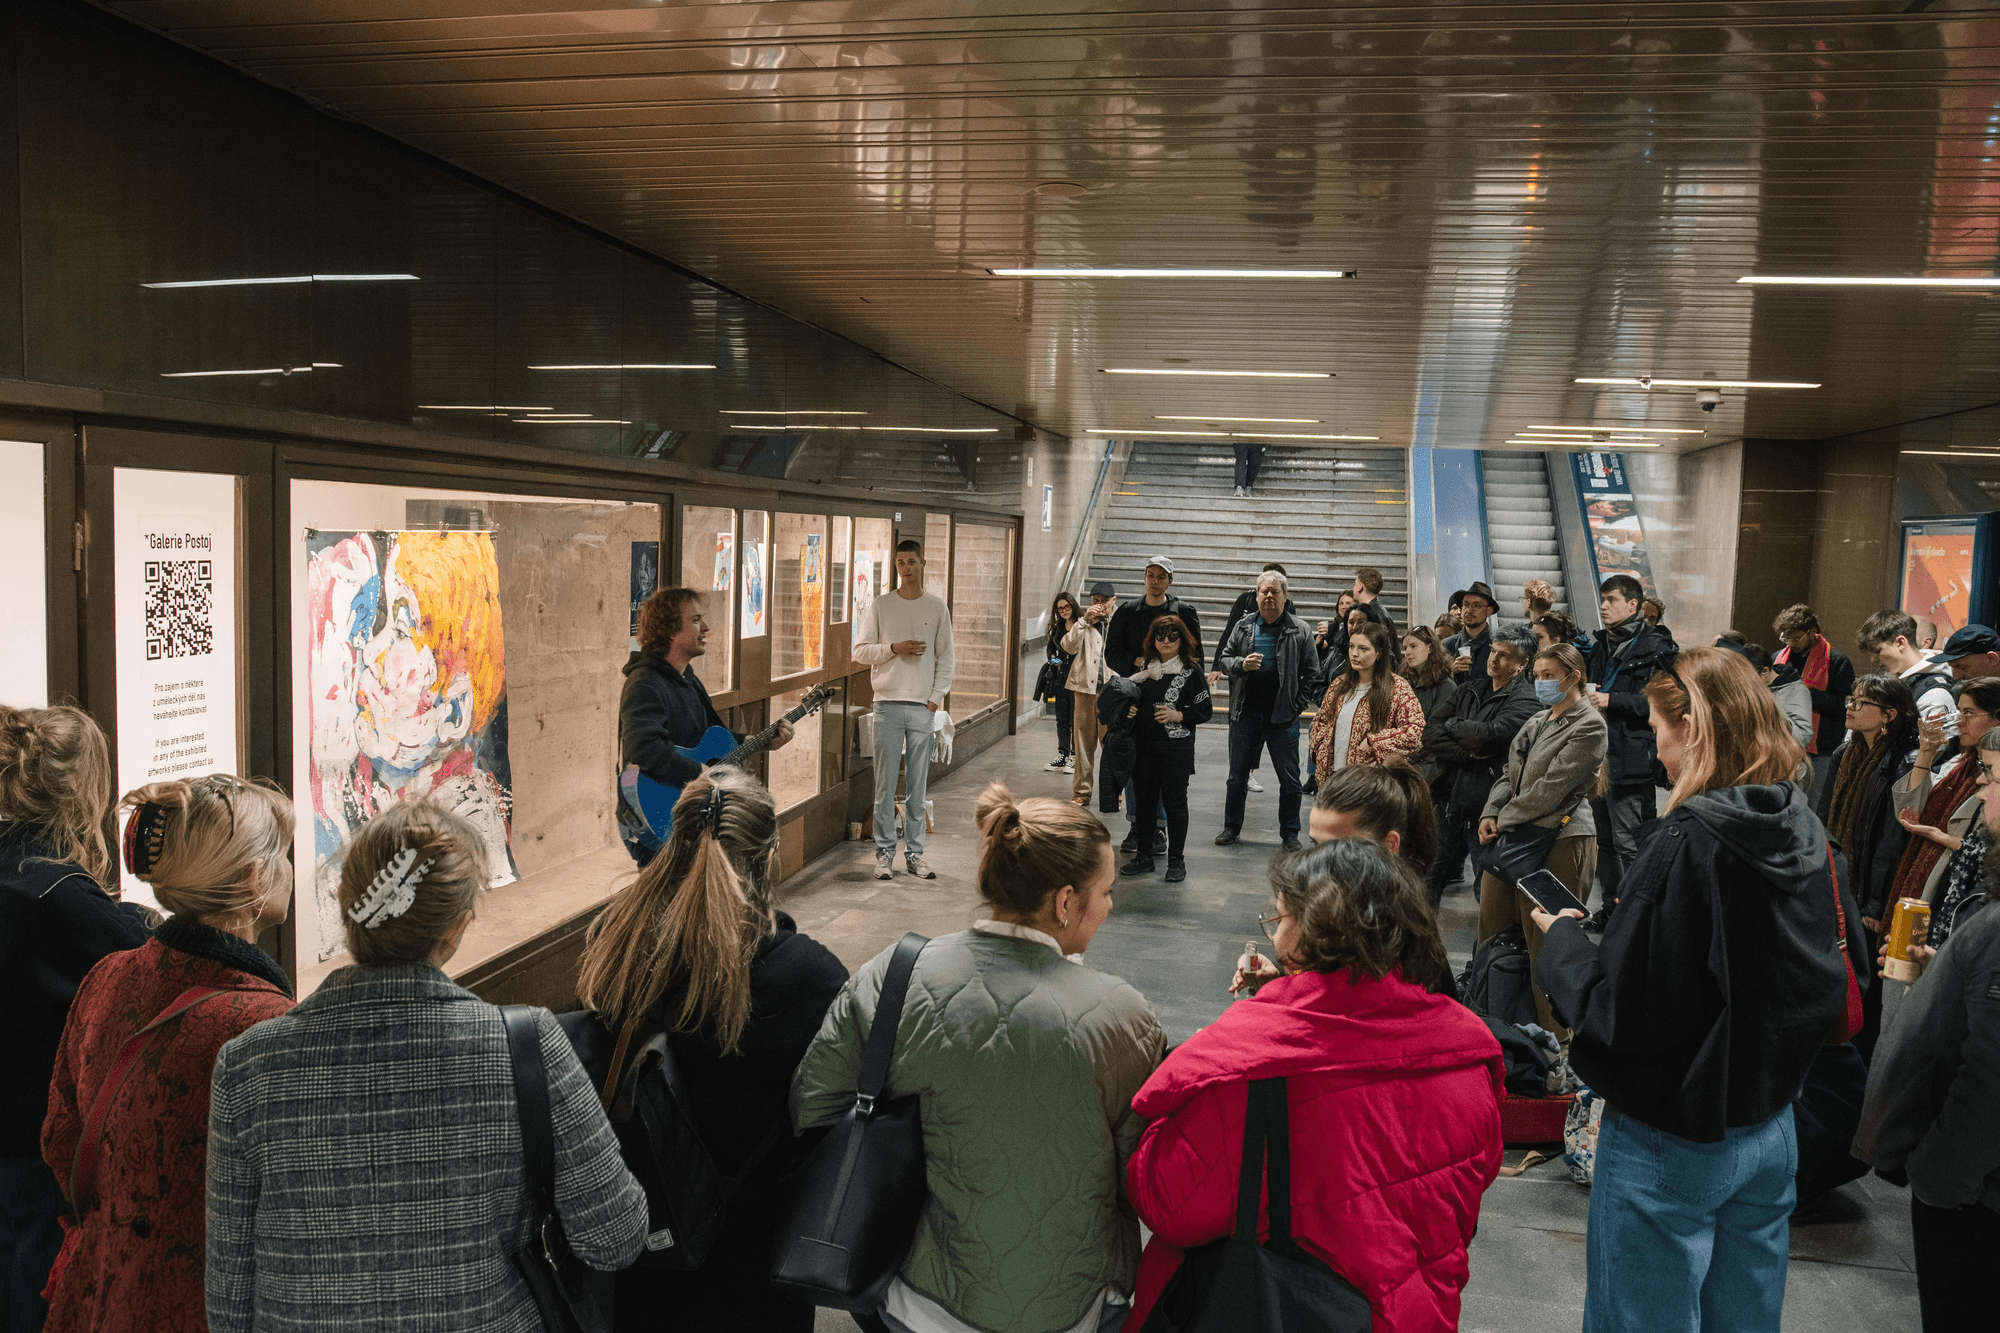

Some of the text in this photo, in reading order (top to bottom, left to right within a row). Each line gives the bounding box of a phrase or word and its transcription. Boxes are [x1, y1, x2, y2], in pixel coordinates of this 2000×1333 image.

[185, 533, 212, 552] Postoj
[155, 683, 164, 692] Pro
[165, 682, 180, 693] zájem
[185, 678, 203, 689] některé
[157, 694, 187, 705] uměleckých
[188, 693, 196, 702] děl
[197, 692, 205, 700] nás
[154, 705, 207, 720] neváhejte kontaktovat
[156, 739, 160, 748] If
[160, 740, 169, 749] you
[180, 731, 204, 743] interested
[153, 744, 207, 762] in any of the exhibited
[148, 757, 214, 777] artworks please contact us
